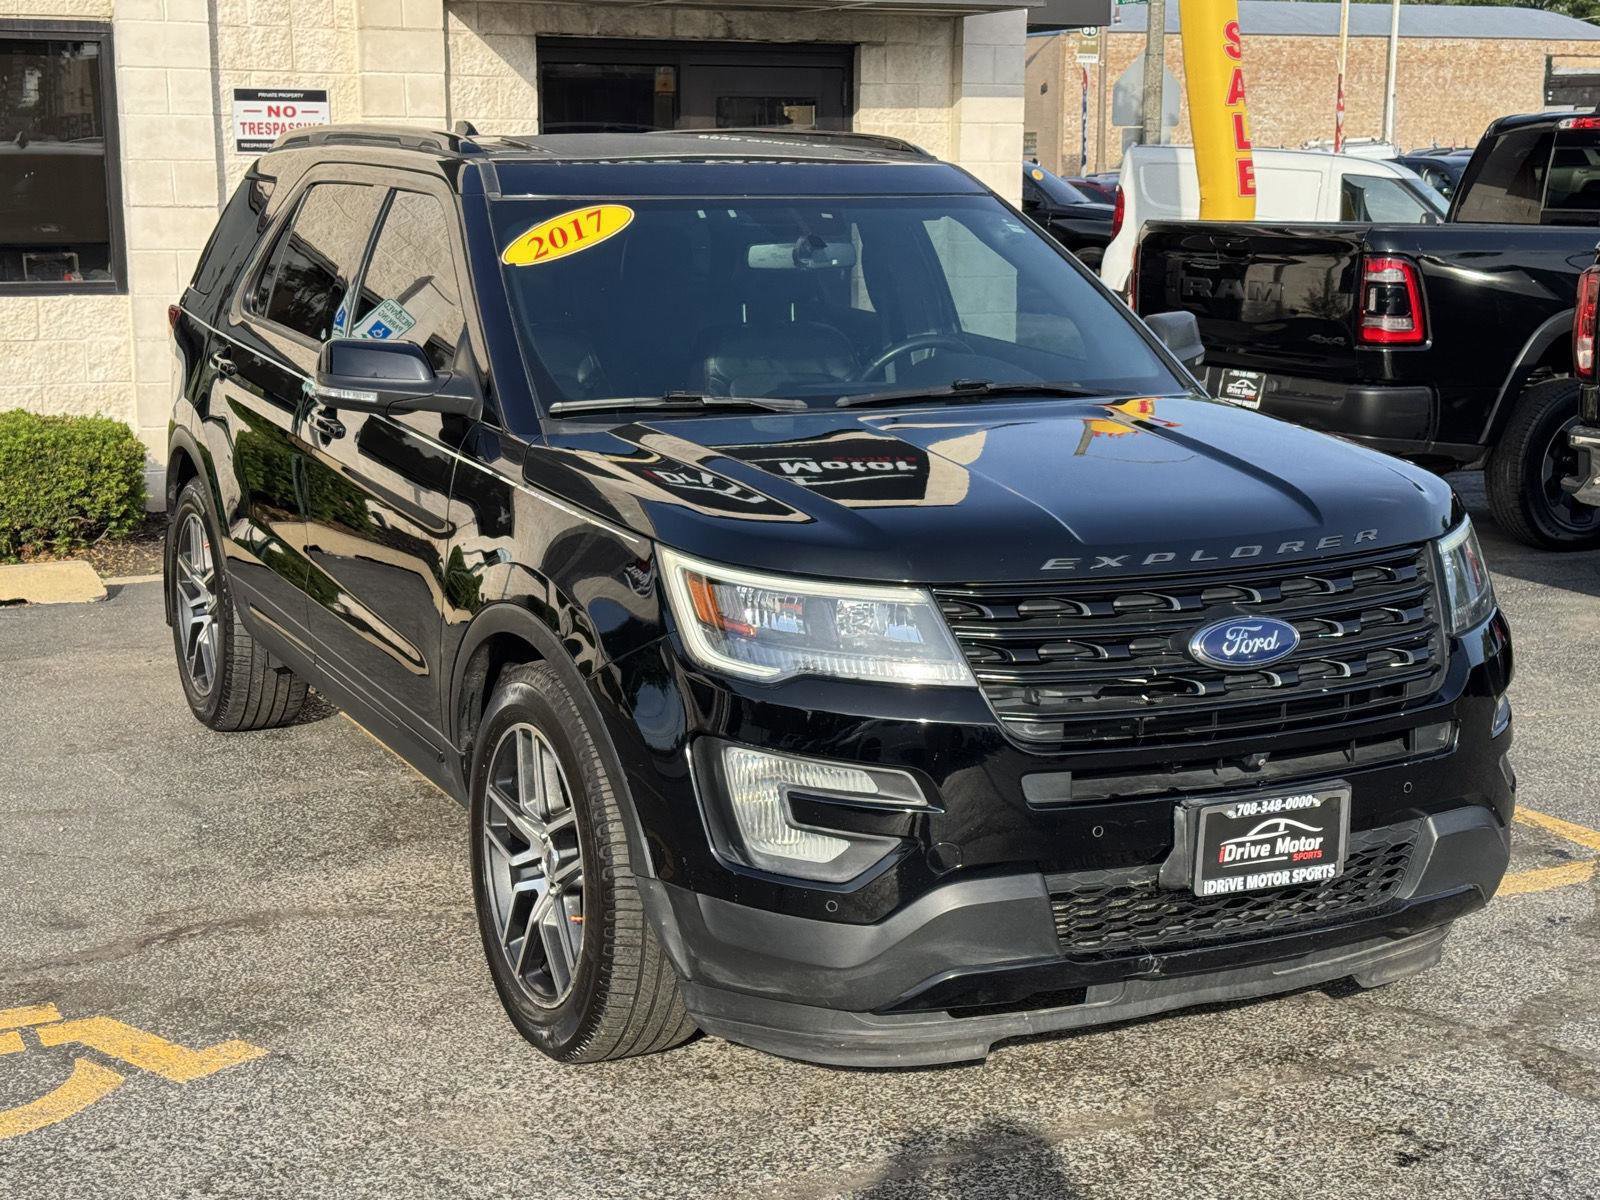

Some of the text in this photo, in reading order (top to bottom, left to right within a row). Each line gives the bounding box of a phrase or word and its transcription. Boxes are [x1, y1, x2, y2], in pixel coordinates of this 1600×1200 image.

[267, 105, 296, 118] NO
[1223, 20, 1257, 197] SALE
[240, 122, 323, 135] TRESPAS
[527, 209, 602, 260] 2017
[1182, 277, 1283, 302] RAM
[1040, 528, 1379, 571] EXPLORER
[1222, 624, 1280, 657] Ford
[1237, 795, 1313, 816] 708-348-0000
[1219, 836, 1323, 863] iDrive Motor
[1292, 850, 1323, 862] SPORTS
[1246, 870, 1290, 889] MOTOR
[1292, 863, 1336, 882] SPORTS
